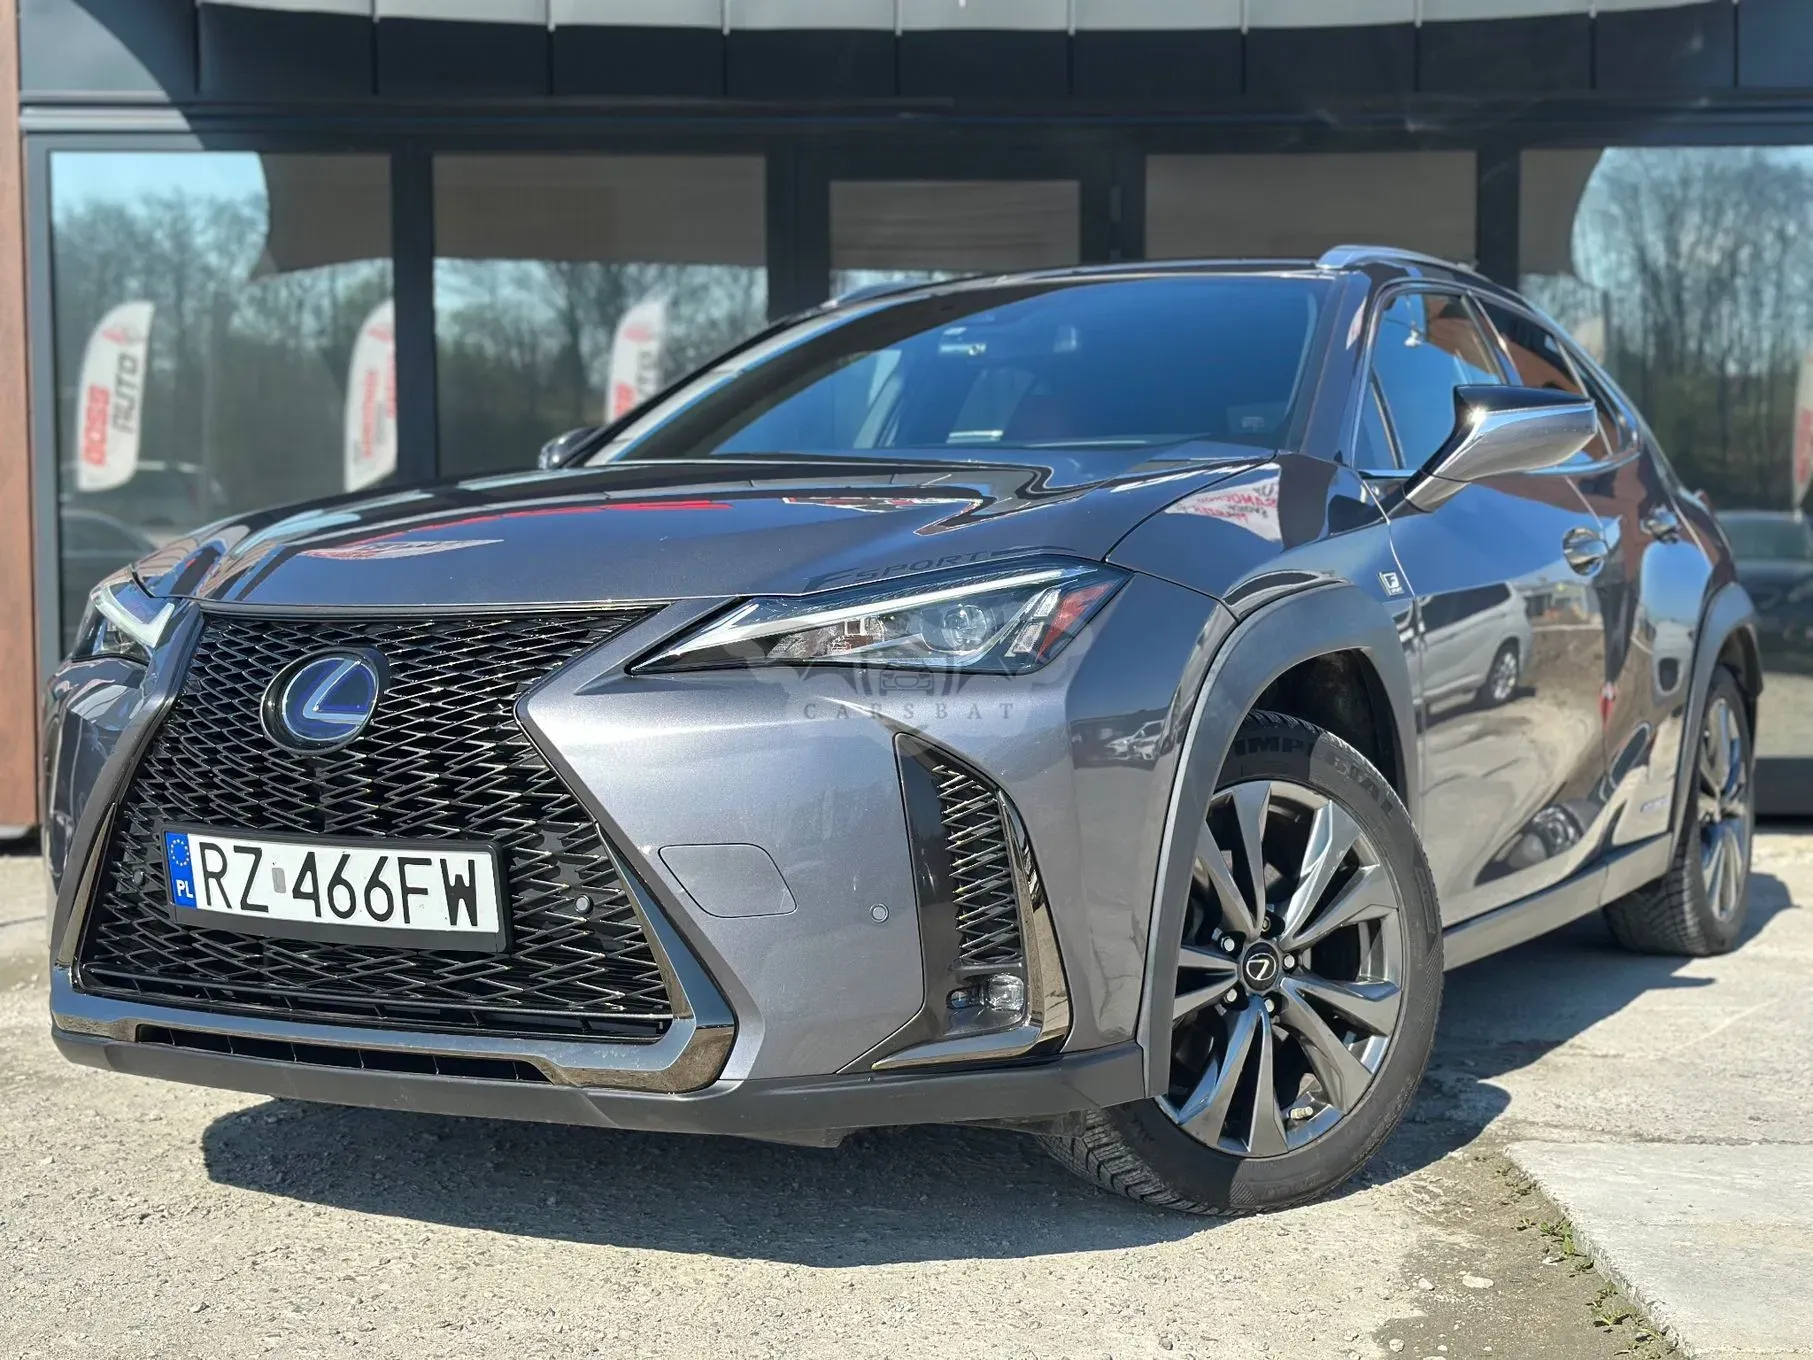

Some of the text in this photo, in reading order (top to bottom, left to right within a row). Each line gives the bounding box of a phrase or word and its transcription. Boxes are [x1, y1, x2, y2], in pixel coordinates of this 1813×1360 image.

[855, 551, 986, 580] SPORT
[176, 878, 194, 899] PL
[199, 841, 479, 927] RZ 466FW
